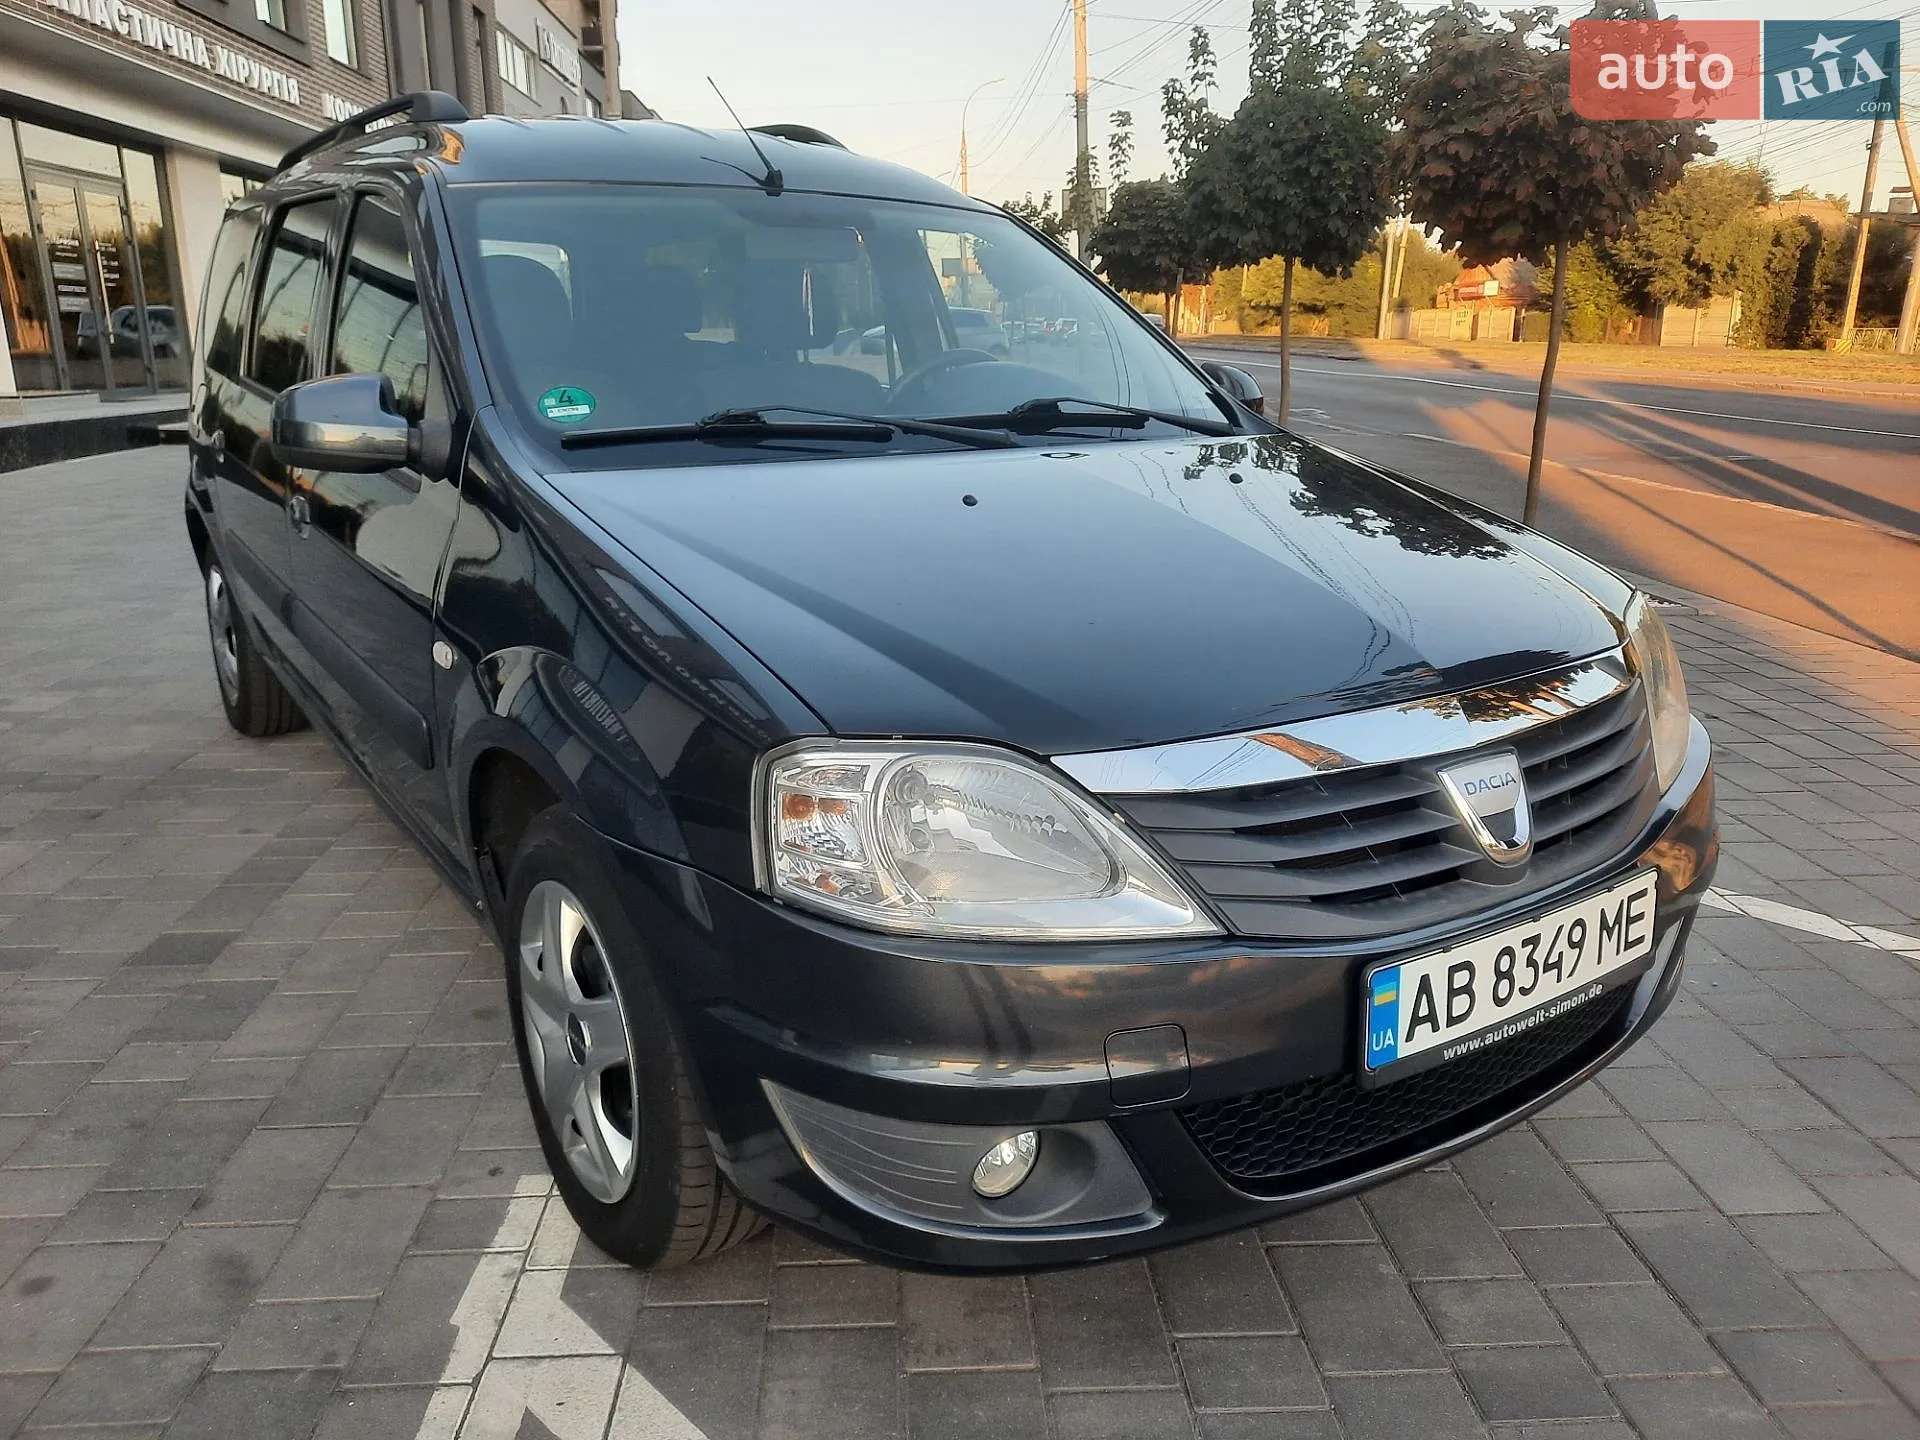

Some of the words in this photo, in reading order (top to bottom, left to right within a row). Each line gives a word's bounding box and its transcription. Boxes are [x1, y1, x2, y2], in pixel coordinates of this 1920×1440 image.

[214, 45, 301, 105] ХІРУРГІЯ
[558, 389, 574, 405] 4
[1463, 771, 1517, 797] DACIA
[1404, 960, 1477, 1044] AB
[1491, 917, 1588, 1008] 8349
[1596, 887, 1650, 966] ME
[1371, 1027, 1395, 1052] UA
[1442, 981, 1604, 1061] www.autowelt-simon.de
